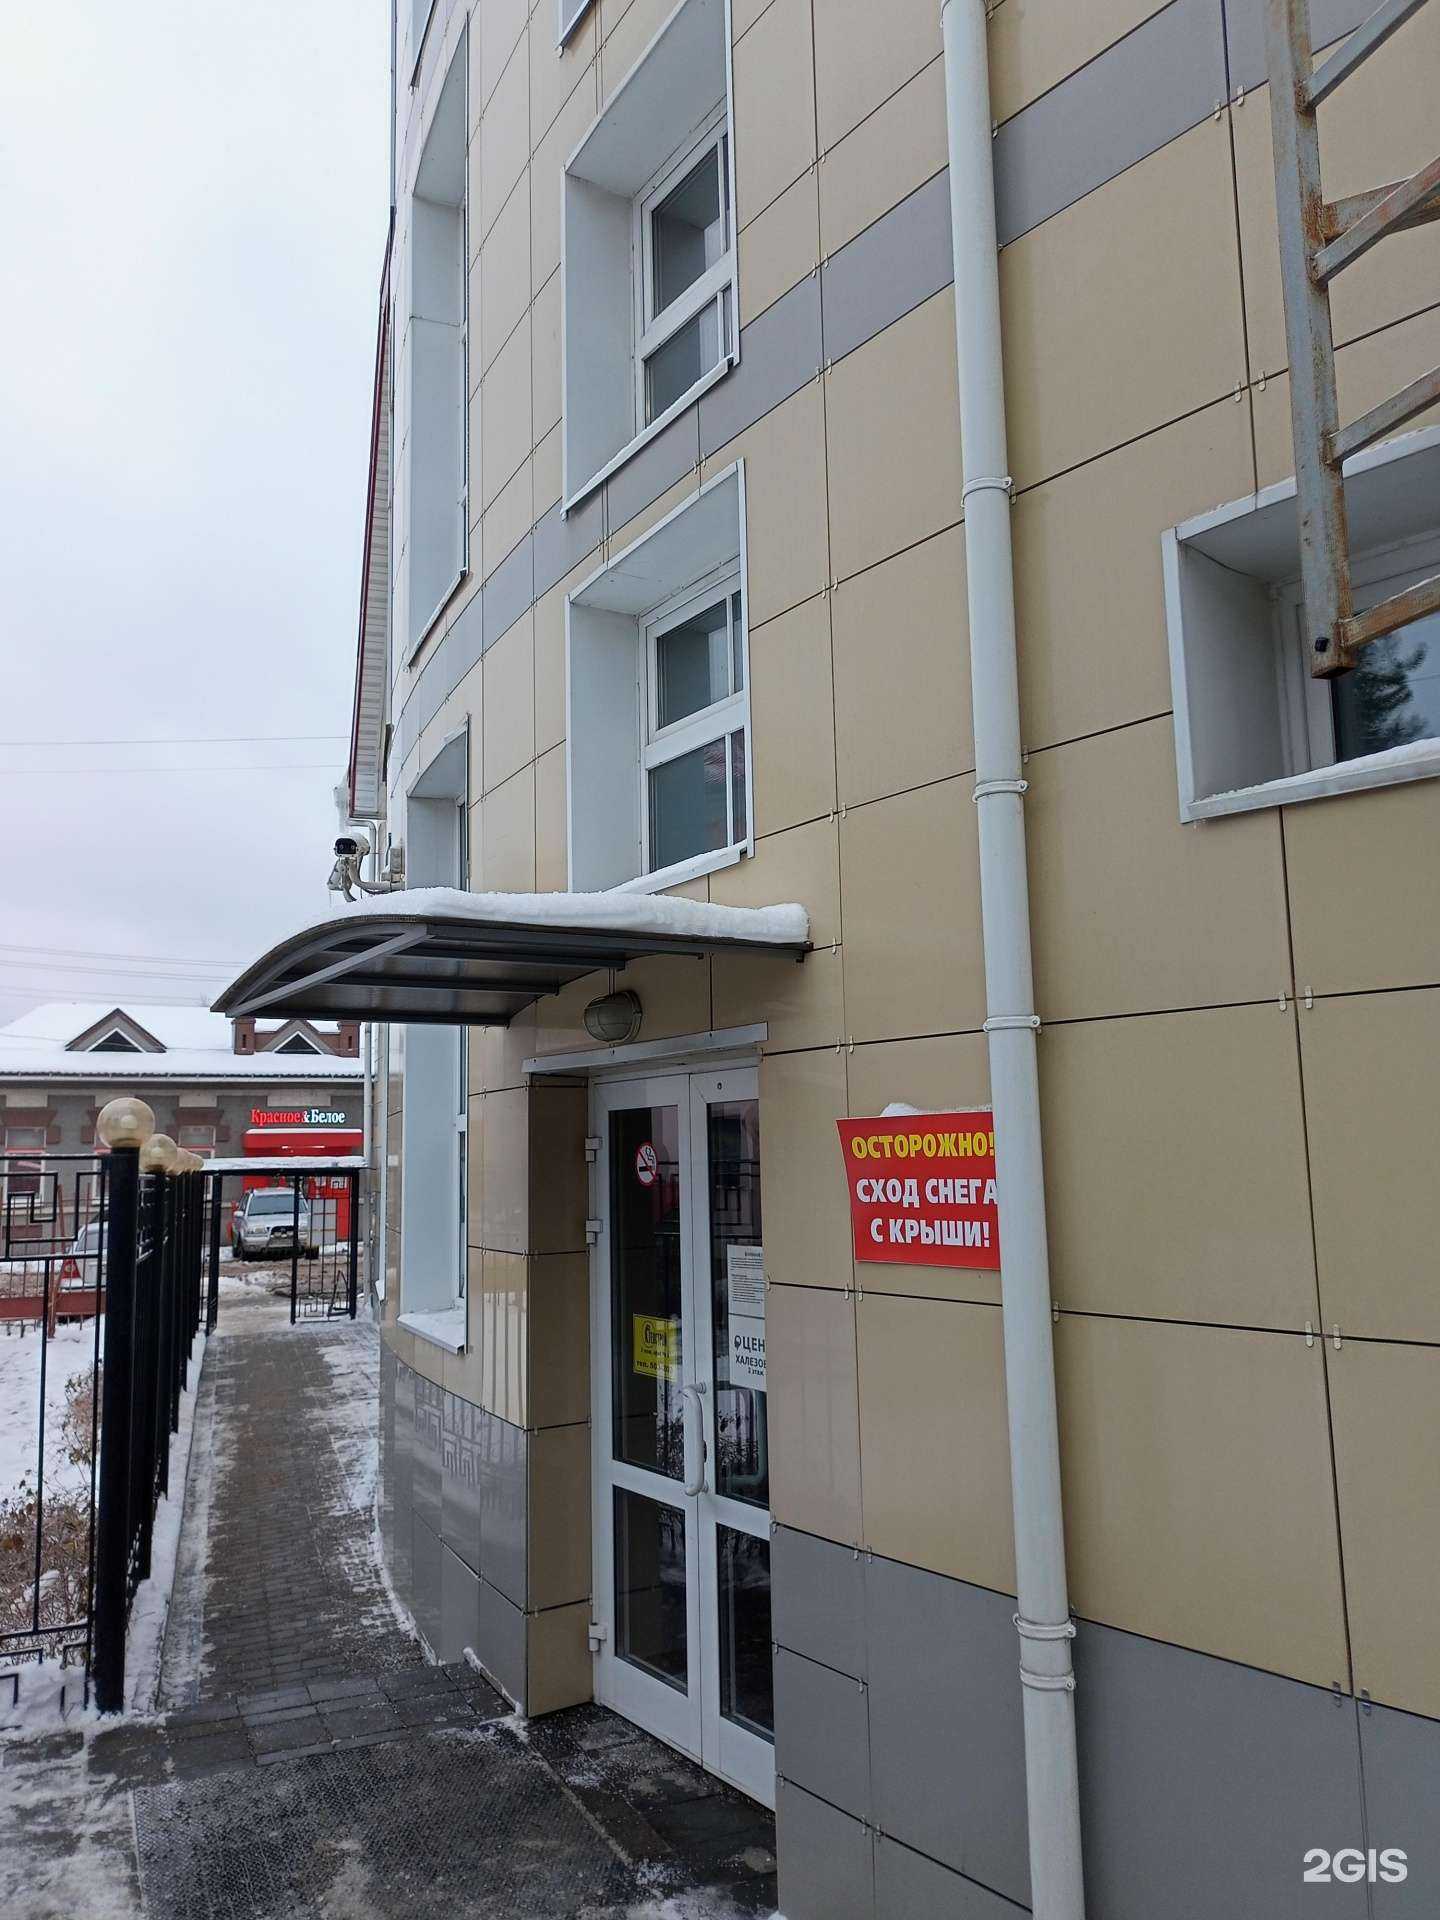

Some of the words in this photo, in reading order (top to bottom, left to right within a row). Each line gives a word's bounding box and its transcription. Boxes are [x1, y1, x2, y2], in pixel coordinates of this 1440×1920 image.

[851, 1131, 995, 1159] ОСТОРОЖНО!
[856, 1178, 920, 1208] СХОД
[925, 1178, 999, 1205] СНЕГА
[870, 1218, 883, 1243] С
[889, 1218, 990, 1248] КРЫШИ!
